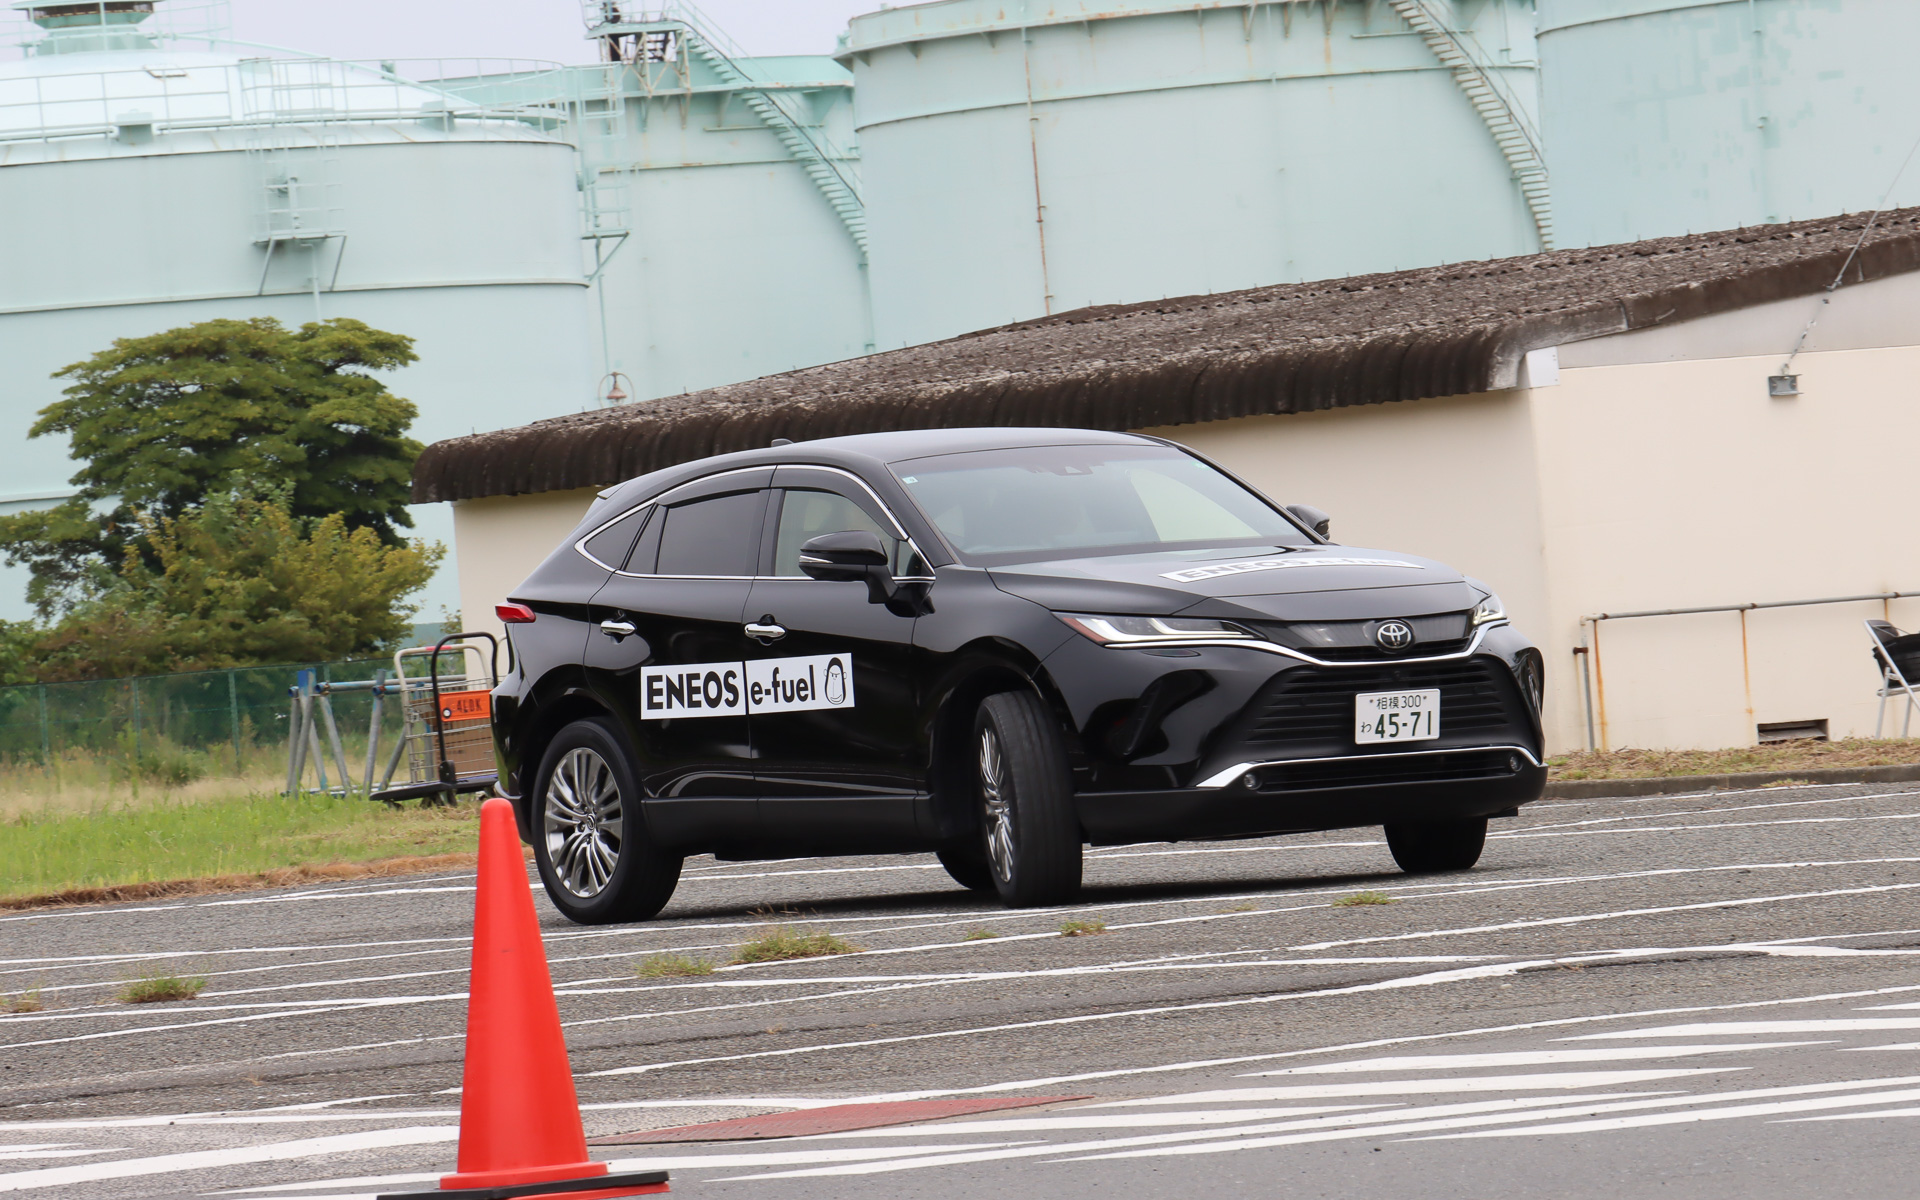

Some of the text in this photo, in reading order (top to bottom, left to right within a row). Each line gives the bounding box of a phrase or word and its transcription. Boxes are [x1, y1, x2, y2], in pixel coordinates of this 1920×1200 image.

[1177, 559, 1309, 579] ENEOS
[646, 664, 816, 710] ENEOS e-fuel
